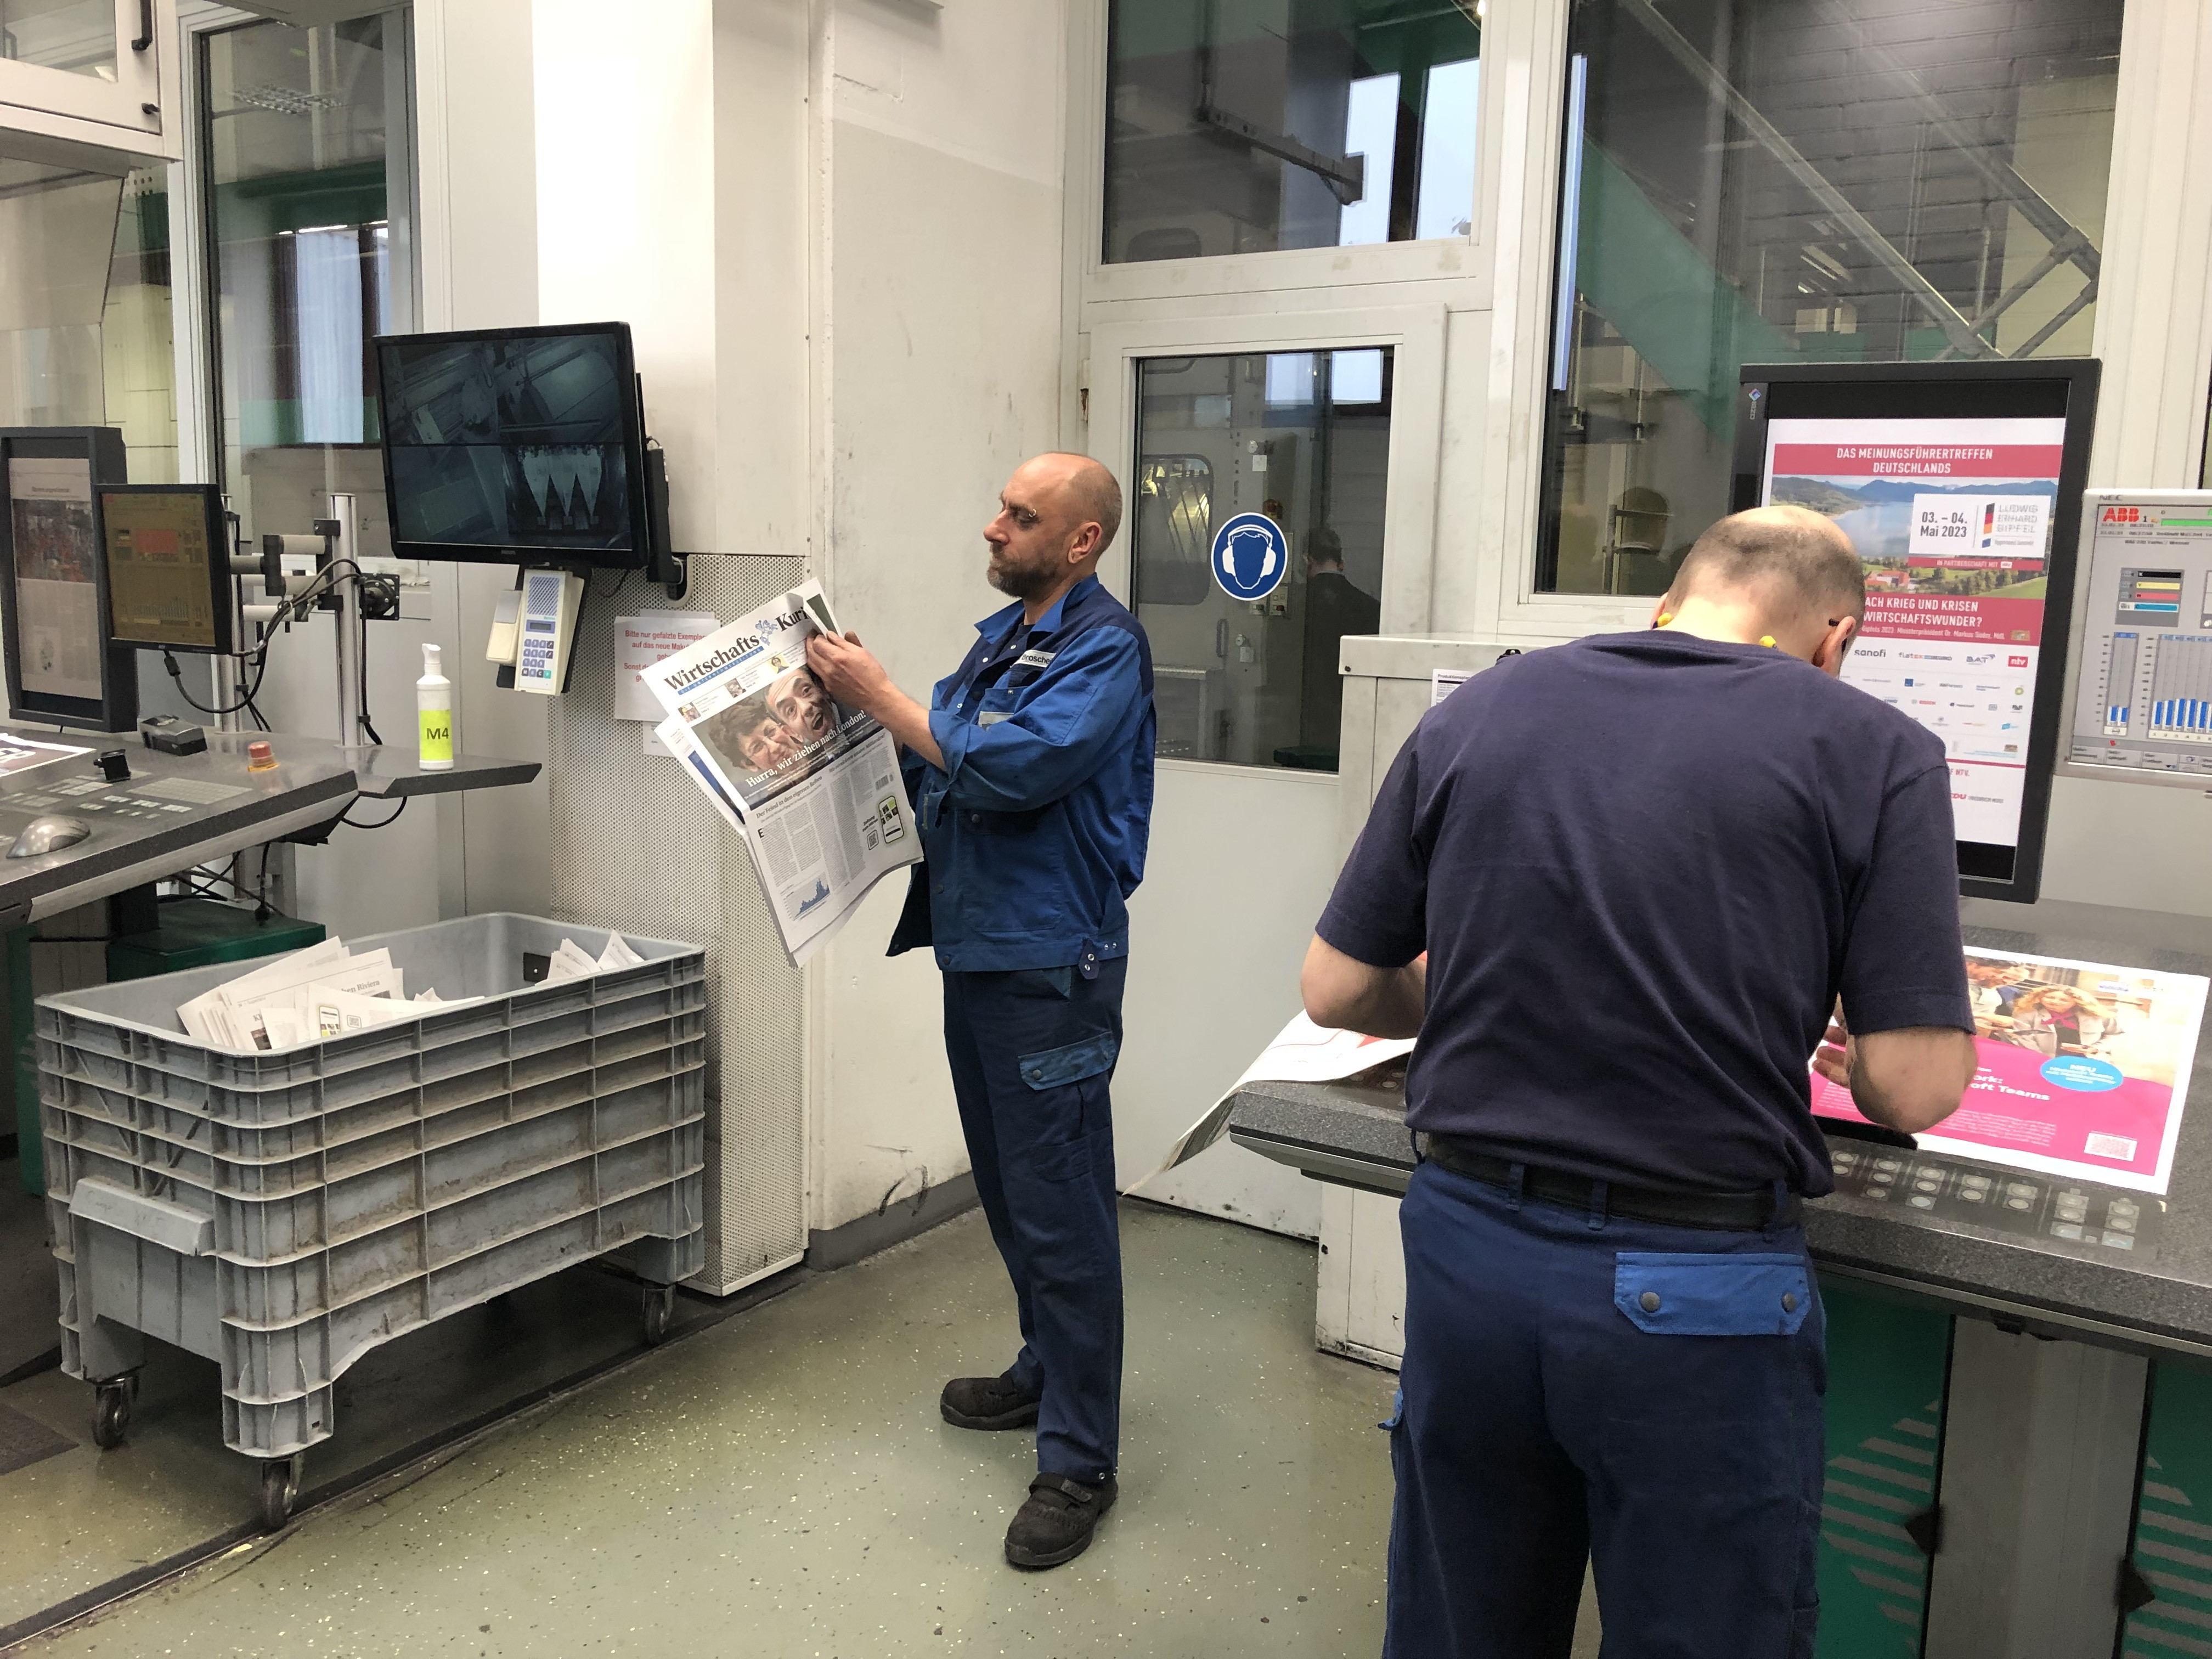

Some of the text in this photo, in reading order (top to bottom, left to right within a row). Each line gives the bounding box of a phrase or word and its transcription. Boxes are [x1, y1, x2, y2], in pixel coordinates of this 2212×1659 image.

[1837, 446, 1993, 460] DAS MEINUNGSFÜHRERTREFFEN
[1873, 462, 1951, 473] DEUTSCHLANDS
[1922, 511, 1938, 524] 03.
[1951, 512, 1967, 524] 04.
[2102, 507, 2140, 522] ABB
[1920, 526, 1967, 538] Mai 2023
[1865, 596, 1979, 612] ACH KRIEG UND KRISEN
[1864, 611, 1983, 628] WIRTSCHAFTSWUNDER?
[652, 631, 676, 640] gefalzte
[664, 606, 809, 690] Wirtschafts Kuri
[1854, 649, 1886, 658] sanofi
[2010, 657, 2026, 665] ntv
[426, 727, 449, 740] M4
[745, 709, 867, 788] Hurra, wir ziehen nach London!
[756, 810, 766, 819] Der
[765, 801, 779, 814] Feind
[783, 793, 793, 805] den
[793, 786, 810, 800] eigenen
[758, 828, 764, 839] E
[357, 980, 381, 991] Riviera
[1997, 1084, 2051, 1101] Teams
